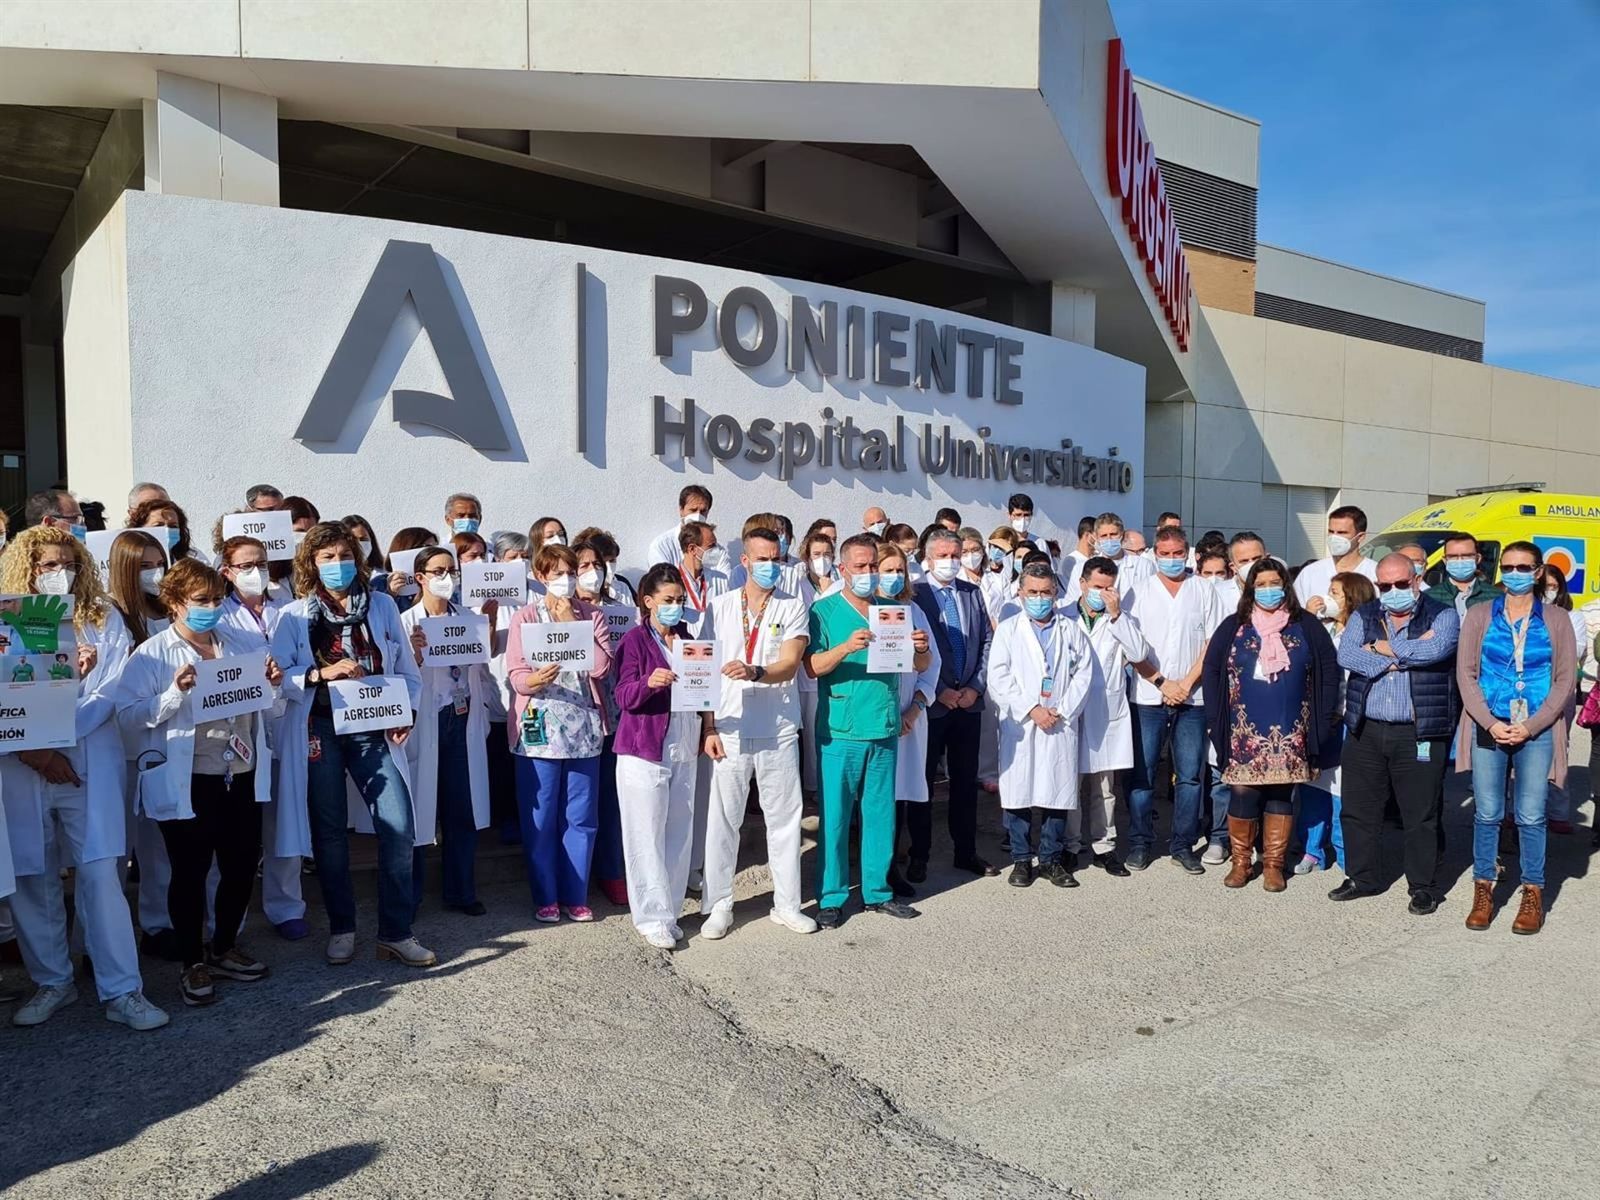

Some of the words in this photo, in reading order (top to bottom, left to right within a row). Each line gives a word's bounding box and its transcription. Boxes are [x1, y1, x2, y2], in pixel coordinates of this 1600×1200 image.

[1106, 39, 1191, 352] URGENCIAS
[654, 275, 1024, 405] PONIENTE
[653, 395, 907, 481] Hospital
[919, 426, 1133, 493] Universitario
[243, 523, 266, 534] STOP
[484, 572, 505, 581] STOP
[470, 587, 519, 598] AGRESIONES
[608, 615, 629, 625] STOP
[444, 626, 467, 637] STOP
[547, 632, 570, 644] STOP
[429, 643, 483, 656] AGRESIONES
[532, 650, 586, 662] AGRESIONES
[217, 668, 242, 683] STOP
[202, 686, 263, 709] AGRESIONES
[359, 686, 383, 699] STOP
[343, 704, 403, 721] AGRESIONES
